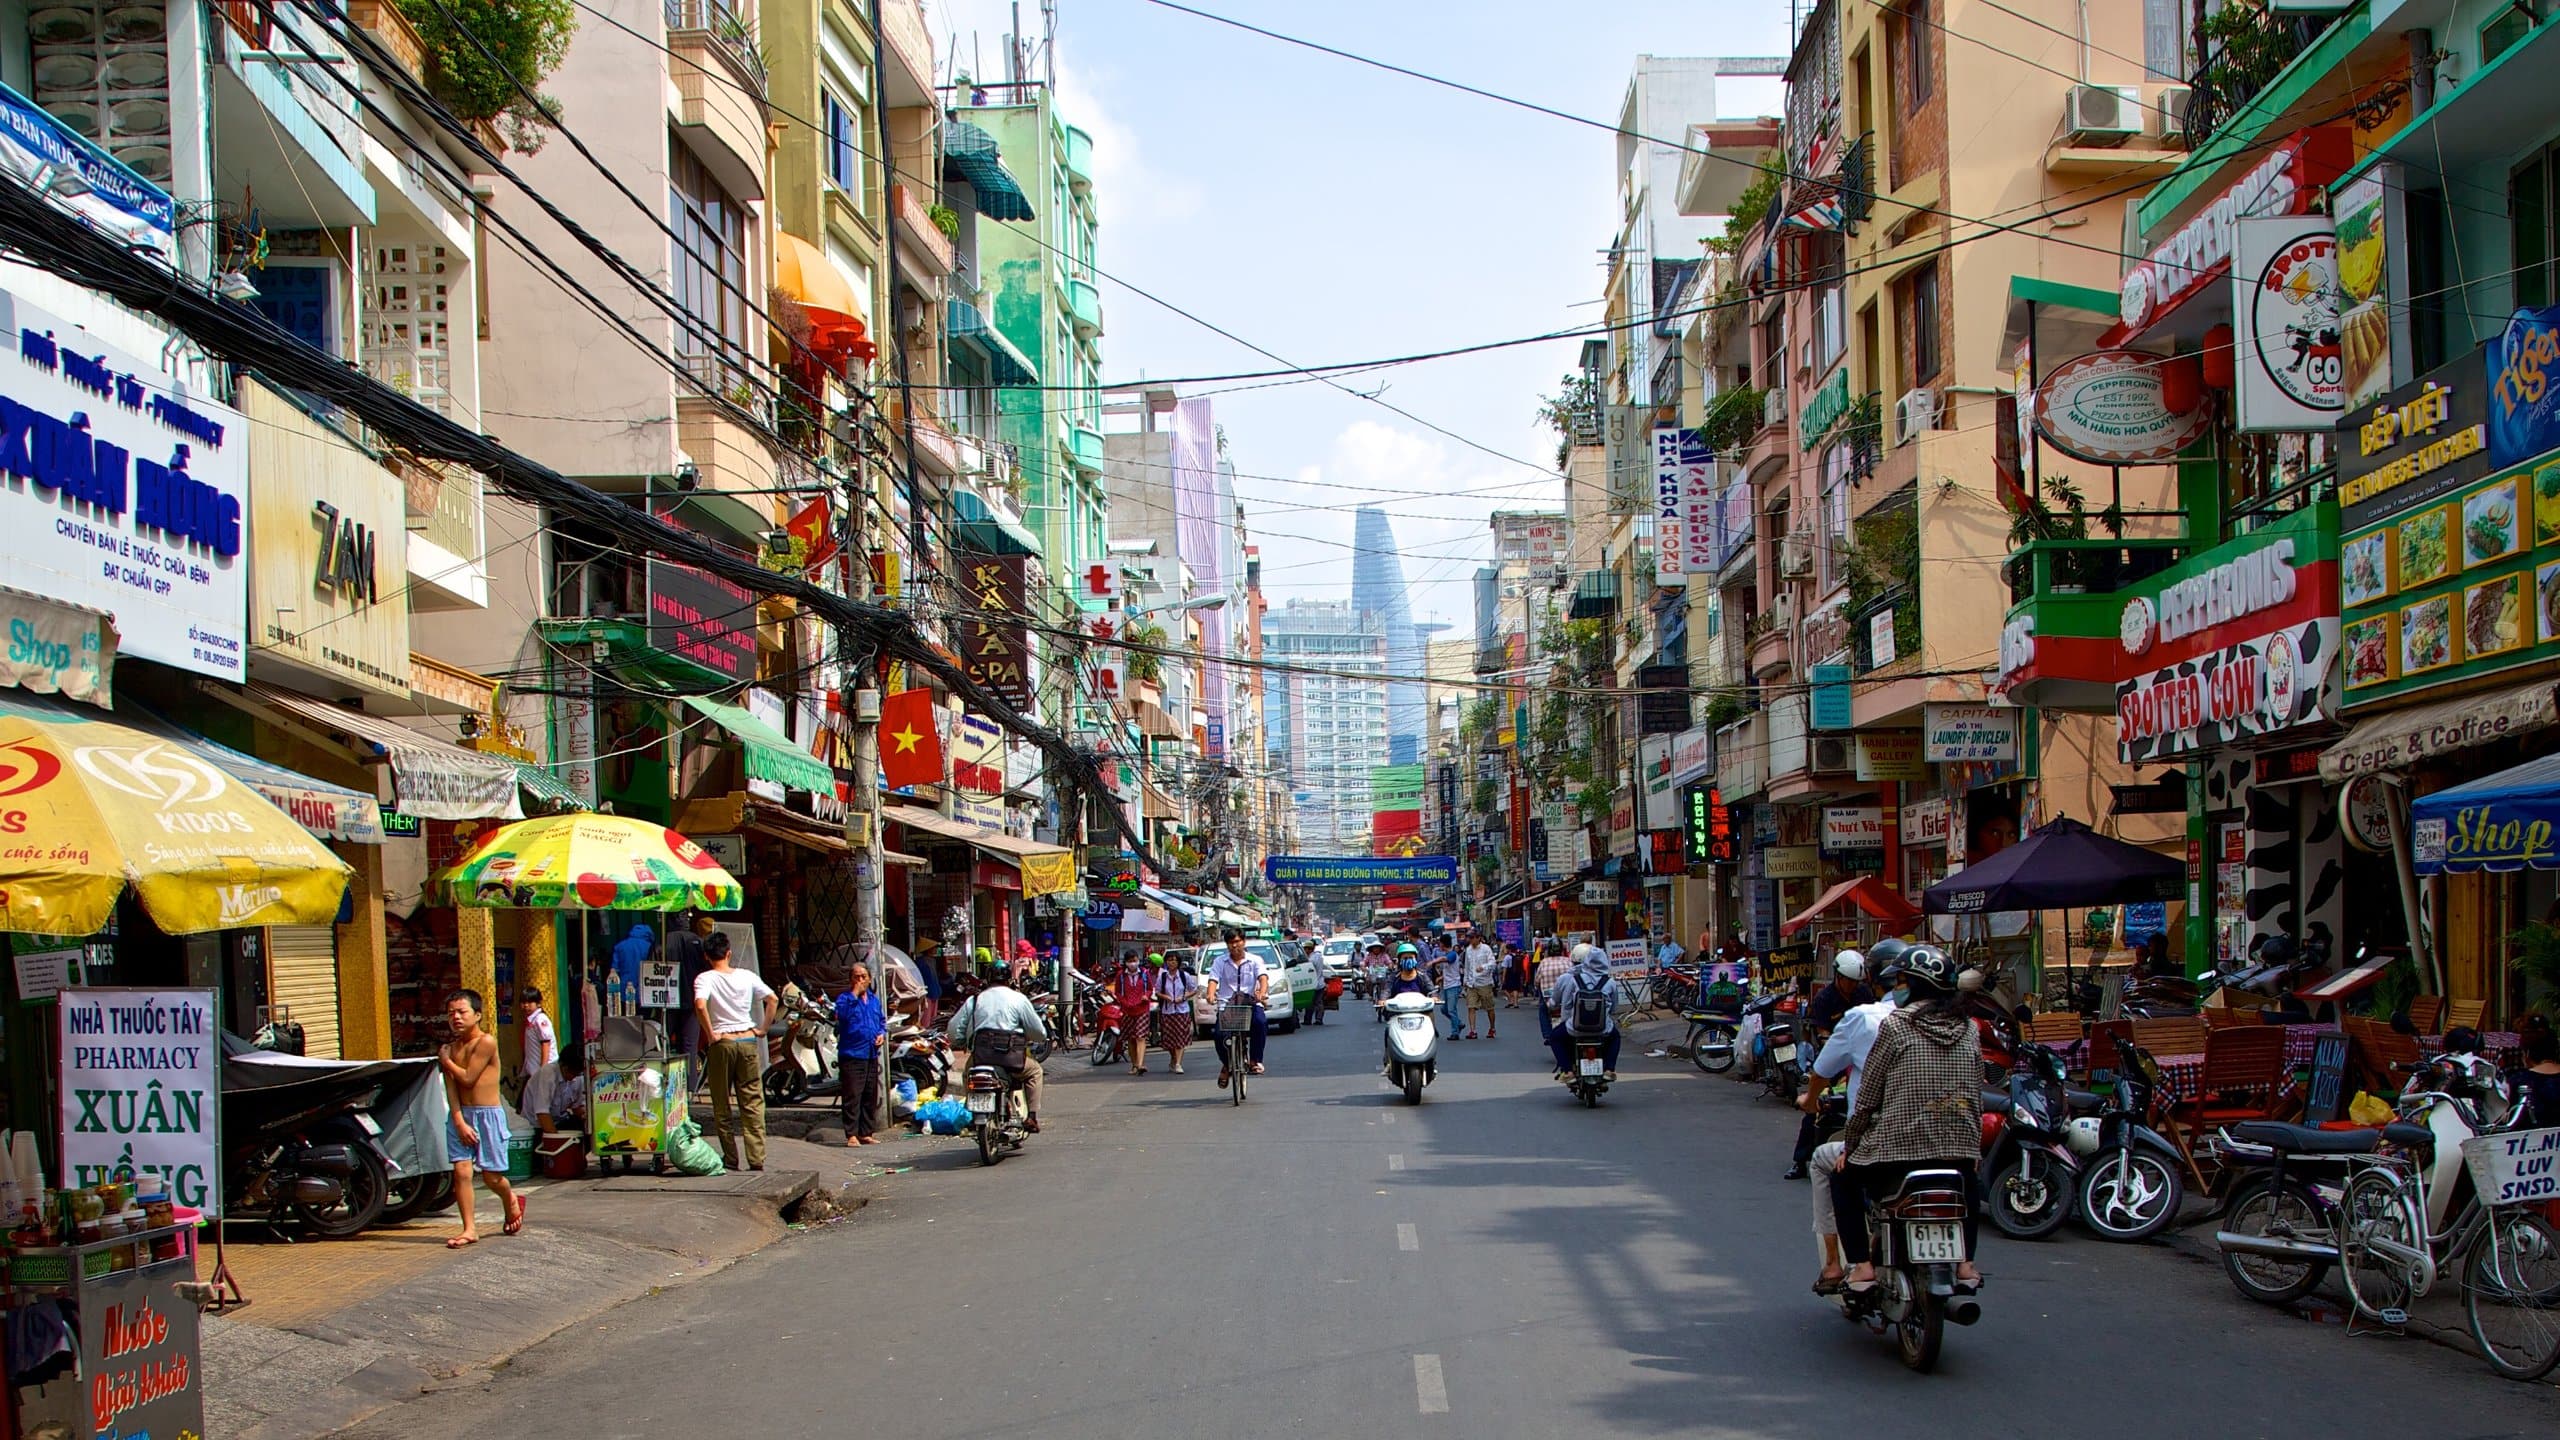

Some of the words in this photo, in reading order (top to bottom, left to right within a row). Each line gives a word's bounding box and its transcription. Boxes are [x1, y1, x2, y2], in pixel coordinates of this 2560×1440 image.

[2265, 240, 2338, 292] SPOT
[2306, 356, 2343, 385] CO
[2126, 392, 2150, 402] 1992
[2091, 411, 2120, 421] PIZZA
[2398, 381, 2452, 438] VIỆT
[2124, 426, 2147, 436] HOA
[0, 395, 129, 514] XUÂN
[1610, 414, 1626, 490] HOTEL
[2338, 453, 2419, 508] VIETNAMESE
[2417, 424, 2487, 473] KITCHEN
[1659, 473, 1679, 518] KHOA
[1530, 526, 1553, 538] KIM'S
[56, 518, 96, 546] CHUYÊN
[98, 533, 117, 552] BÁN
[133, 545, 161, 568] THUỐC
[190, 565, 210, 586] BỆNH
[104, 562, 119, 580] ĐẠT
[122, 567, 152, 593] CHUẨN
[154, 579, 171, 597] GPP
[9, 617, 71, 687] Shop
[968, 661, 1022, 685] SPA
[2121, 673, 2202, 744] SPOTTED
[2210, 656, 2257, 723] COW
[1941, 708, 2004, 719] CAPITAL
[1870, 751, 1914, 761] GALLERY
[2339, 745, 2399, 774] Crepe
[2407, 732, 2424, 755] &
[2430, 715, 2510, 749] Coffee
[289, 792, 337, 831] HỒNG
[382, 812, 414, 830] THER
[1545, 803, 1562, 816] Cold
[155, 811, 255, 834] KIDO'S
[2447, 805, 2555, 860] Shop
[3, 845, 43, 861] cuộc
[48, 842, 89, 866] sống
[1275, 865, 1298, 880] QUẬN
[216, 883, 282, 918] Merino
[85, 943, 115, 967] SHOES
[241, 935, 258, 958] OFF
[1763, 962, 1812, 984] LAUNDRY
[70, 1001, 105, 1034] NHÀ
[109, 997, 166, 1034] THUỐC
[170, 1001, 203, 1034] TÂY
[74, 1047, 201, 1070] PHARMACY
[74, 1078, 204, 1134] XUÂN
[2515, 1156, 2553, 1177] LUV
[2501, 1177, 2560, 1200] SNSD.
